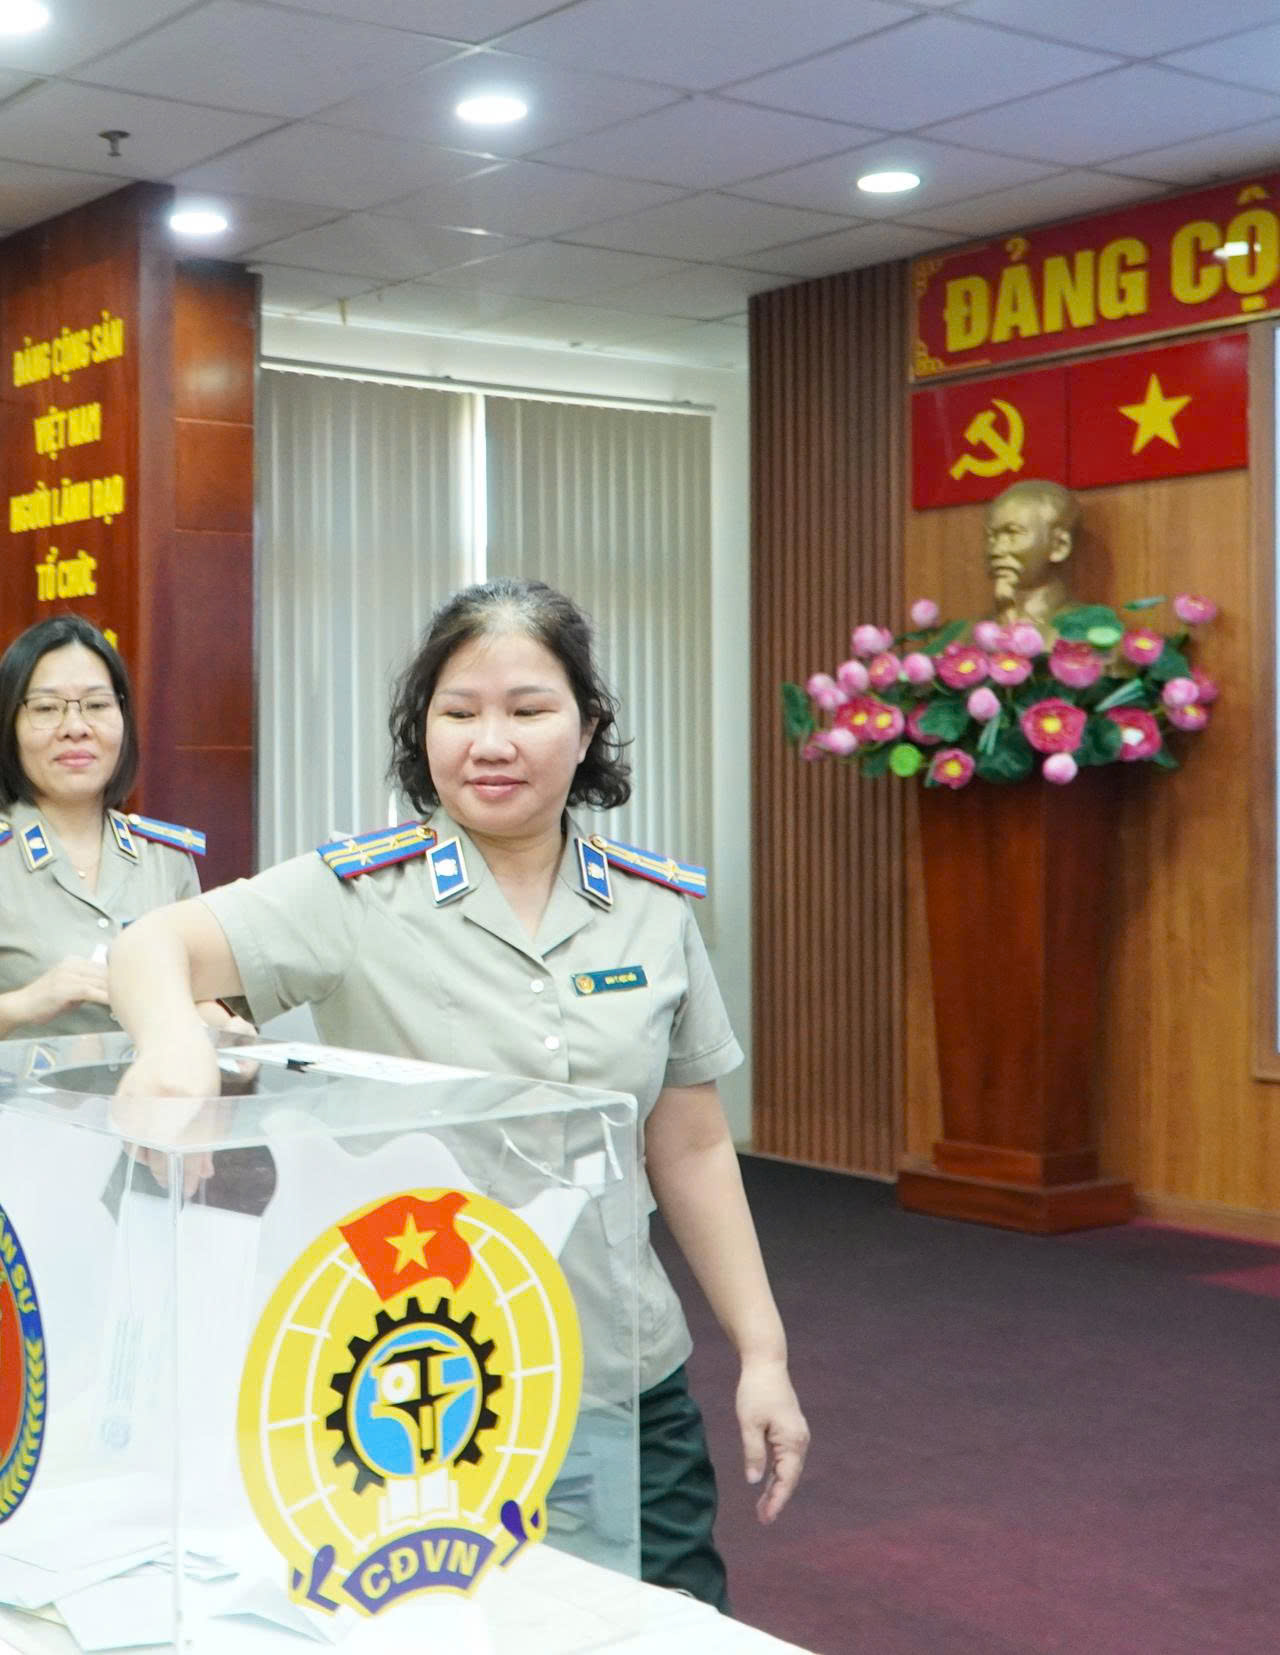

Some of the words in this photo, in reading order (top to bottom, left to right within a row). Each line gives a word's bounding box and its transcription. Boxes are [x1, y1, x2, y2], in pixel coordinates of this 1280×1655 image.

[944, 237, 1148, 352] ĐẢNG
[1170, 185, 1280, 314] CỘ
[33, 405, 66, 460] VIỆT
[67, 401, 102, 448] NAM
[360, 1538, 480, 1600] CĐVN
